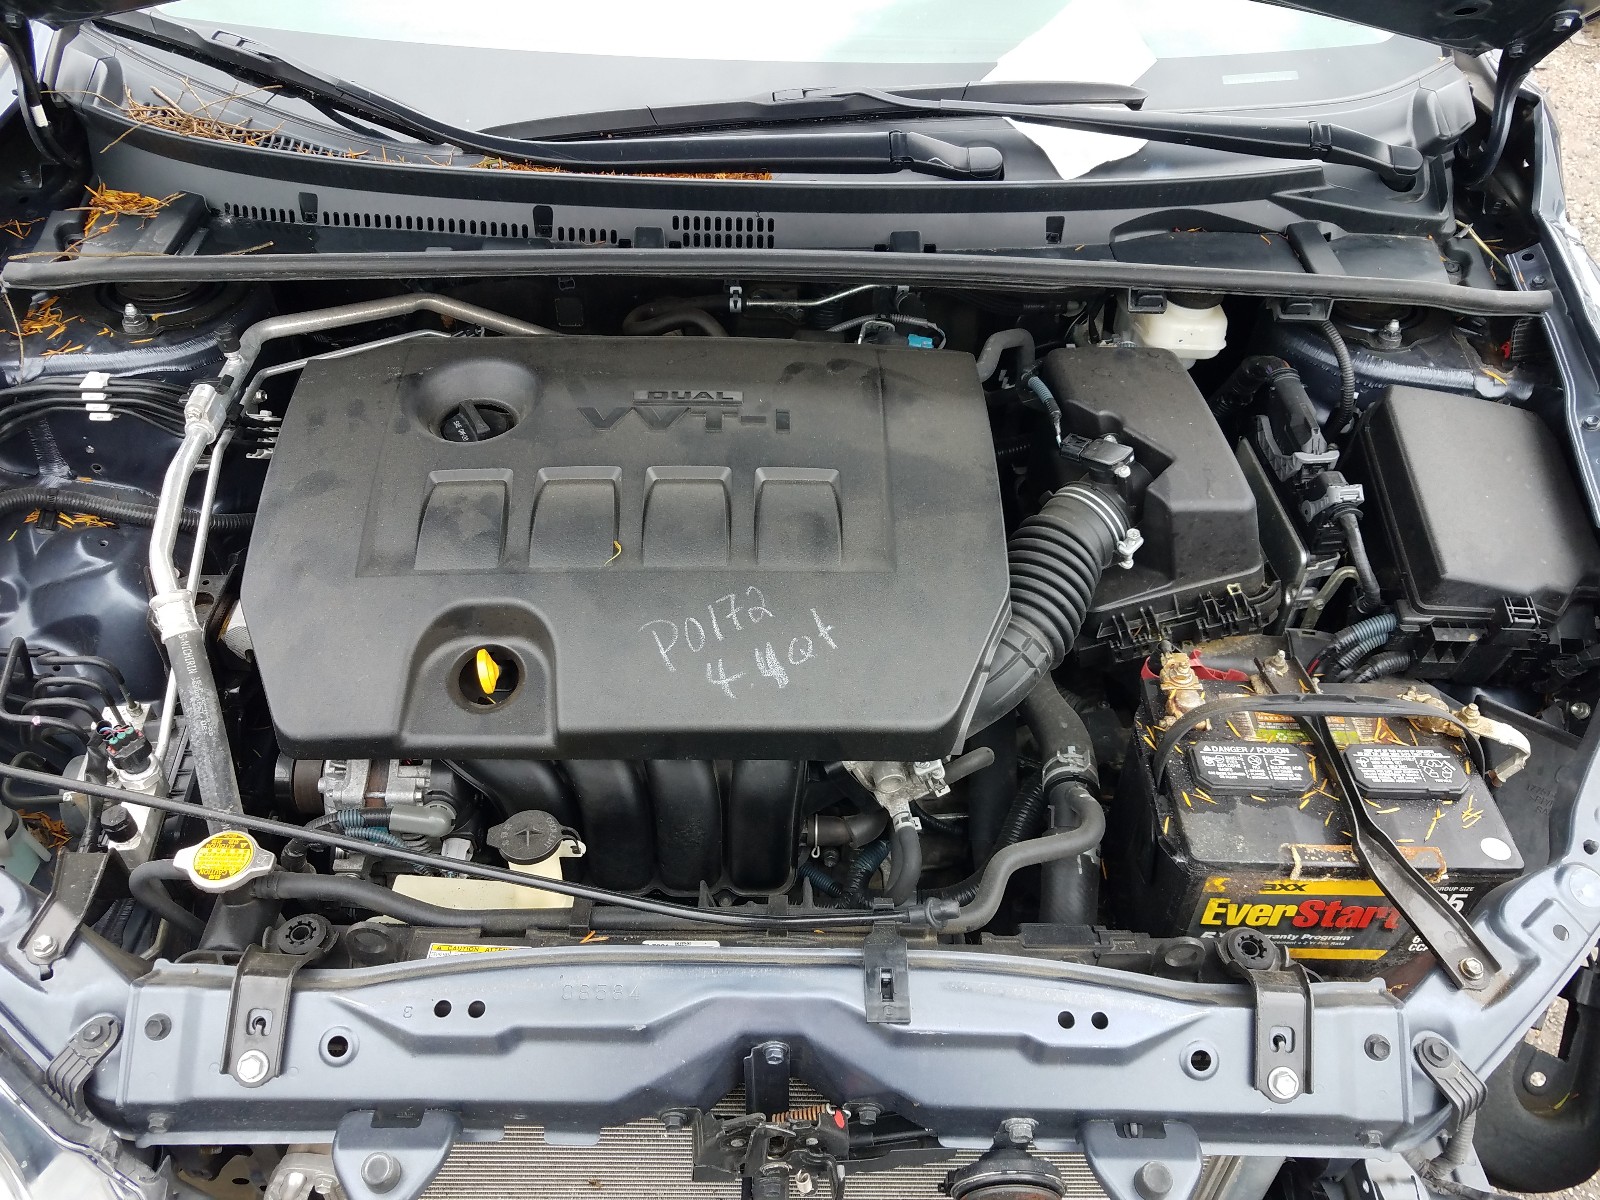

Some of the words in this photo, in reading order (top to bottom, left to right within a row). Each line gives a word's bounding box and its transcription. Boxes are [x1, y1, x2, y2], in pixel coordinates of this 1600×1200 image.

[647, 390, 735, 401] DUAL
[1210, 745, 1248, 753] DANGER
[1200, 897, 1401, 930] EverStart
